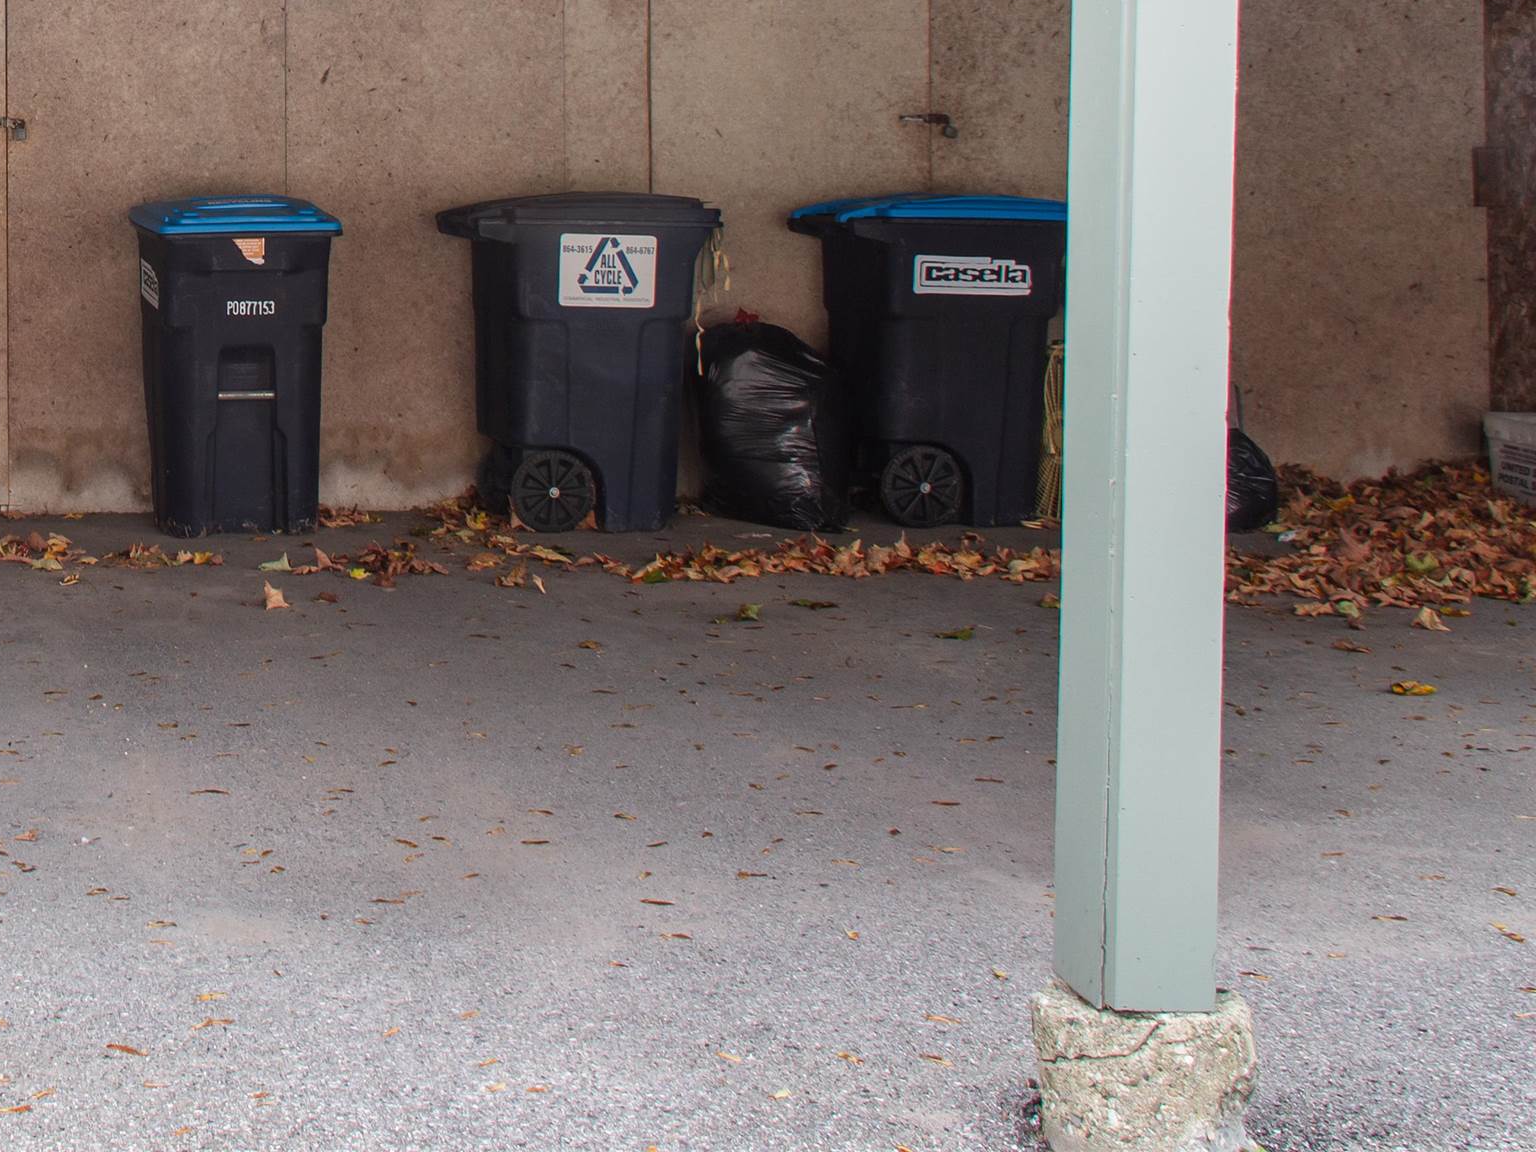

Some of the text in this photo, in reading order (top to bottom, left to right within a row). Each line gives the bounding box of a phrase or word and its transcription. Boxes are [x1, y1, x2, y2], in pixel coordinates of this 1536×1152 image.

[600, 254, 617, 269] ALL
[594, 270, 622, 285] CYCLE
[924, 265, 1028, 283] casella
